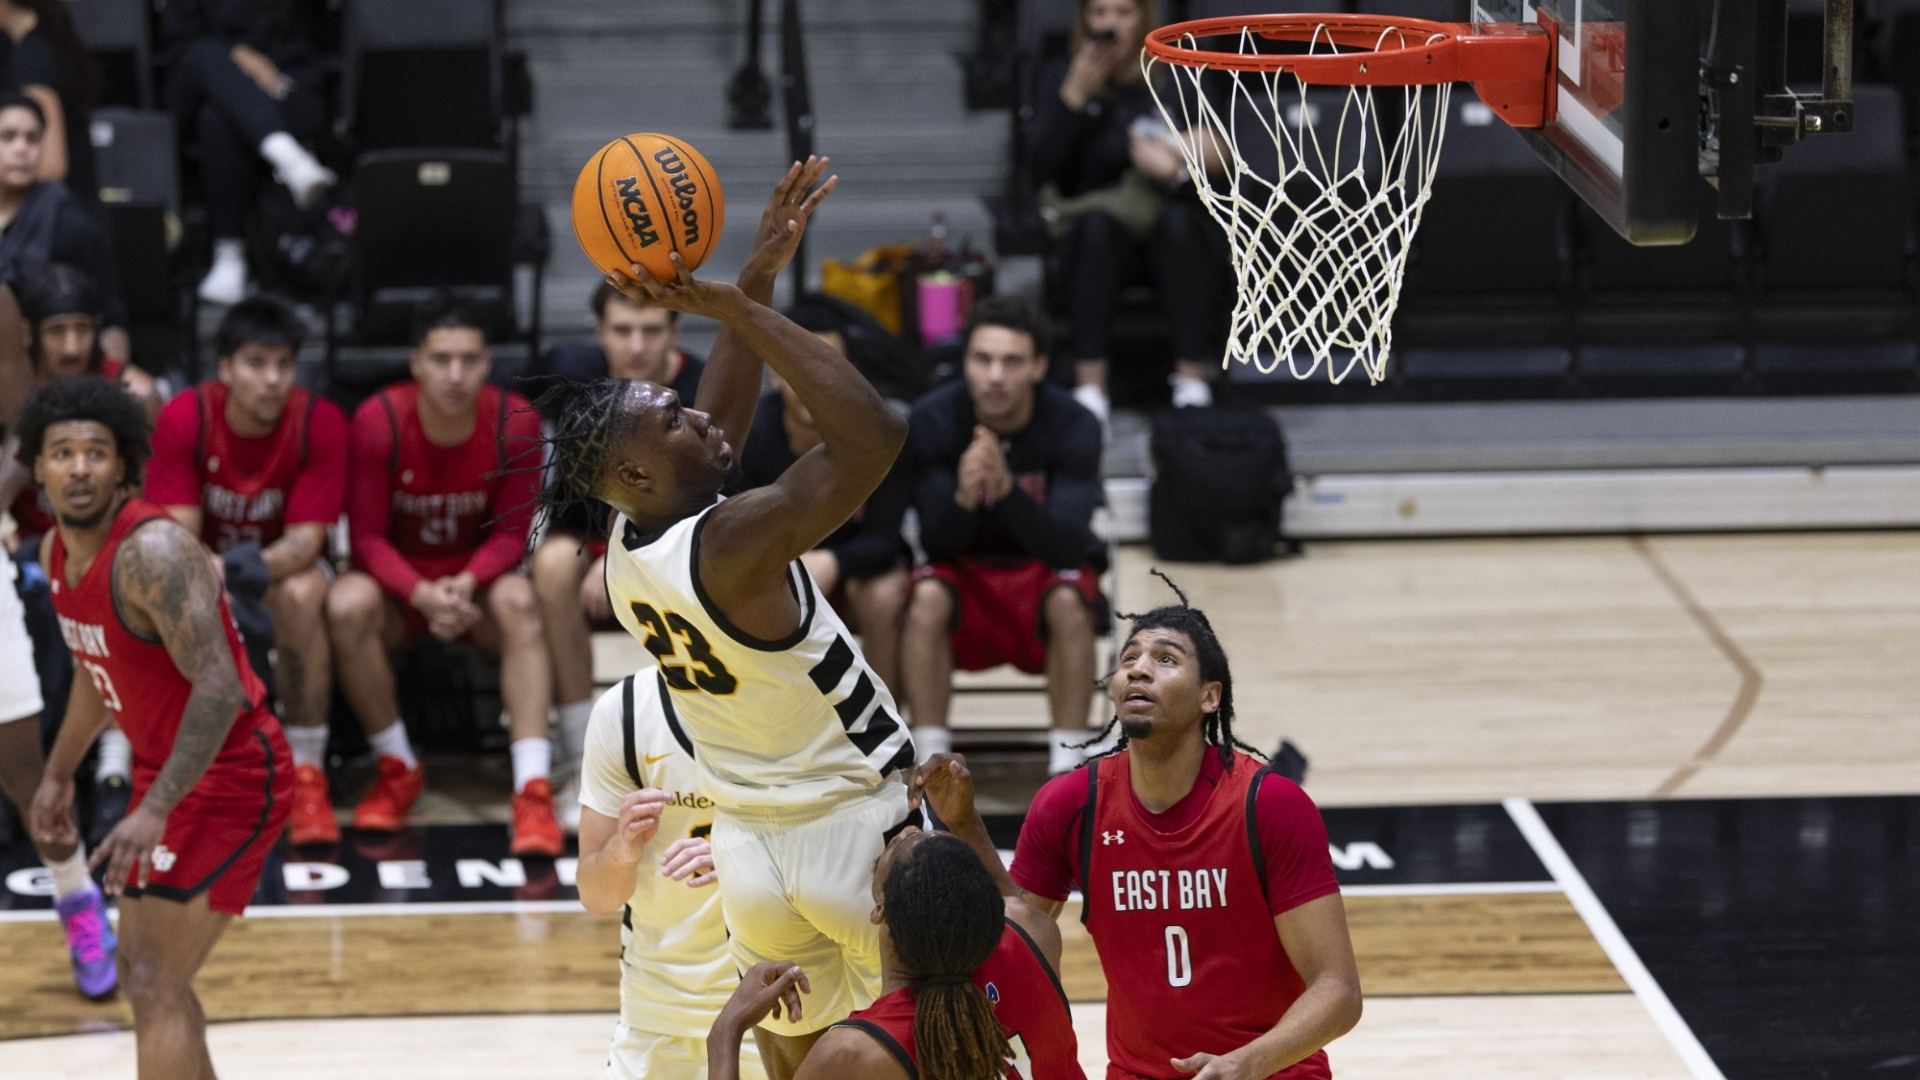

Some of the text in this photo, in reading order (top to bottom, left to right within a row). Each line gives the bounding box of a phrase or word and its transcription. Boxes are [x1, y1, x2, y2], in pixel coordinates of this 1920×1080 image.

[615, 175, 660, 249] NCAA
[653, 147, 700, 247] Wilson
[629, 599, 738, 696] 23
[1112, 868, 1228, 911] EAST BAY
[1164, 924, 1193, 988] 0
